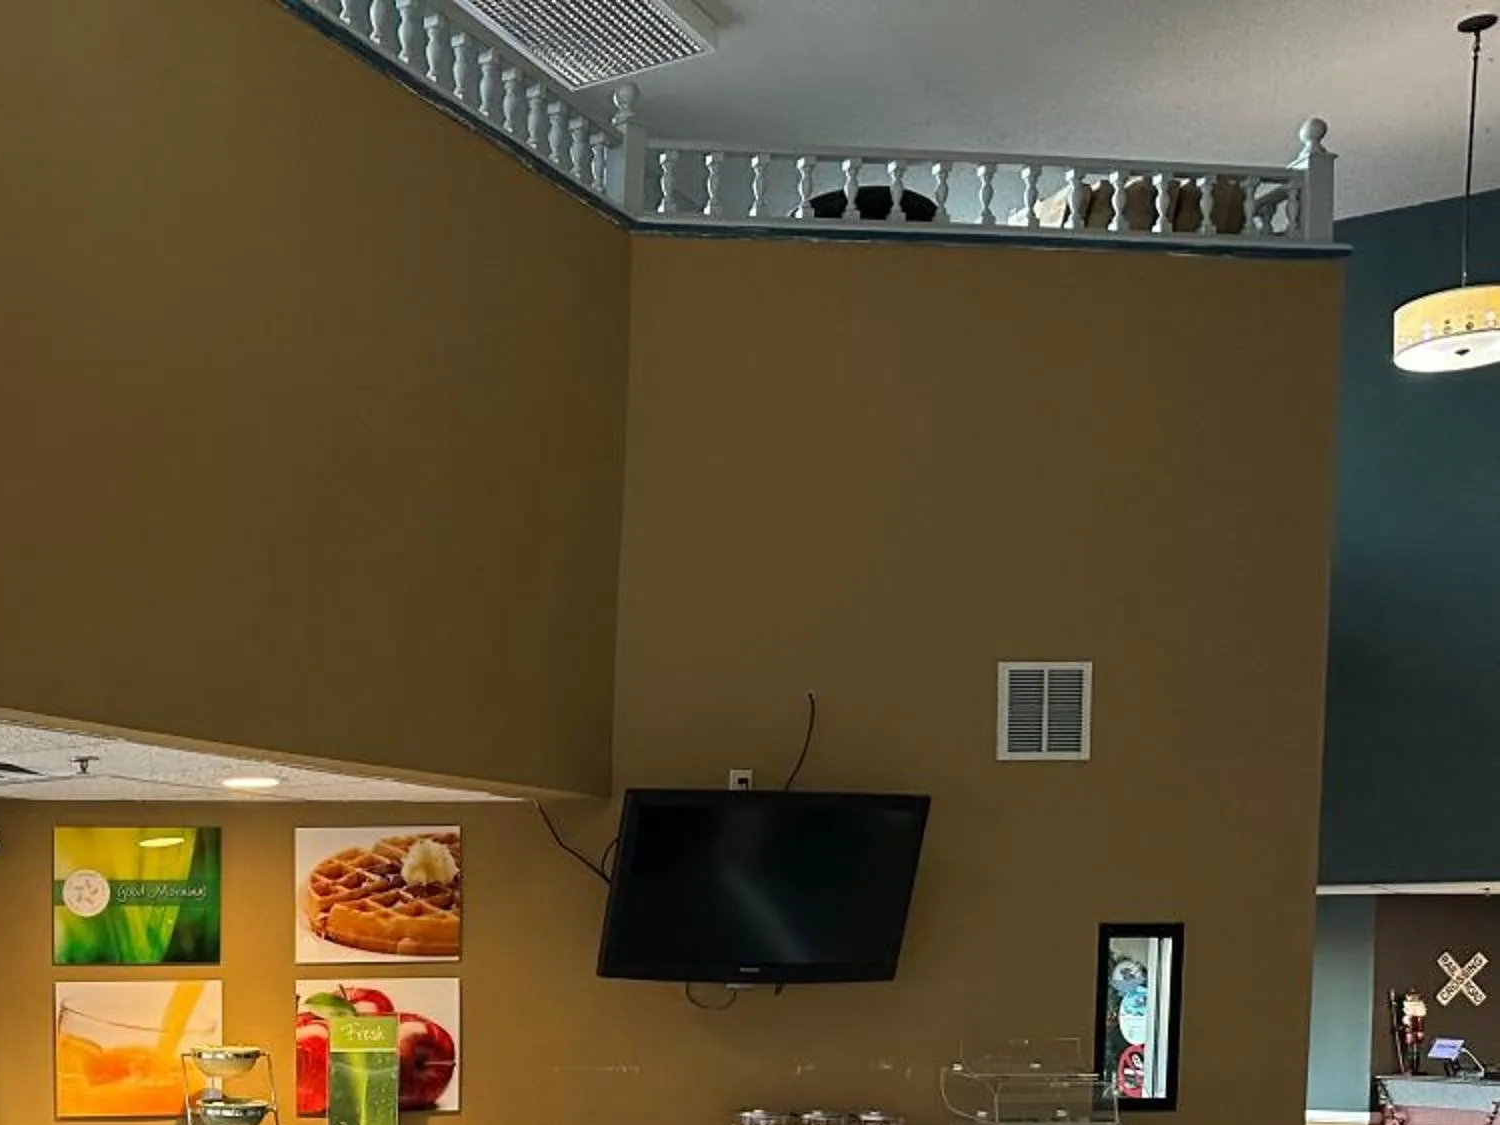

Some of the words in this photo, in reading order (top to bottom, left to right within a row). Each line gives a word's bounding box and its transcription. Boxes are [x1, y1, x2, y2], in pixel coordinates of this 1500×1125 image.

[116, 882, 145, 902] Good
[1440, 955, 1484, 1001] CROSSING
[340, 1022, 386, 1041] Fresh
